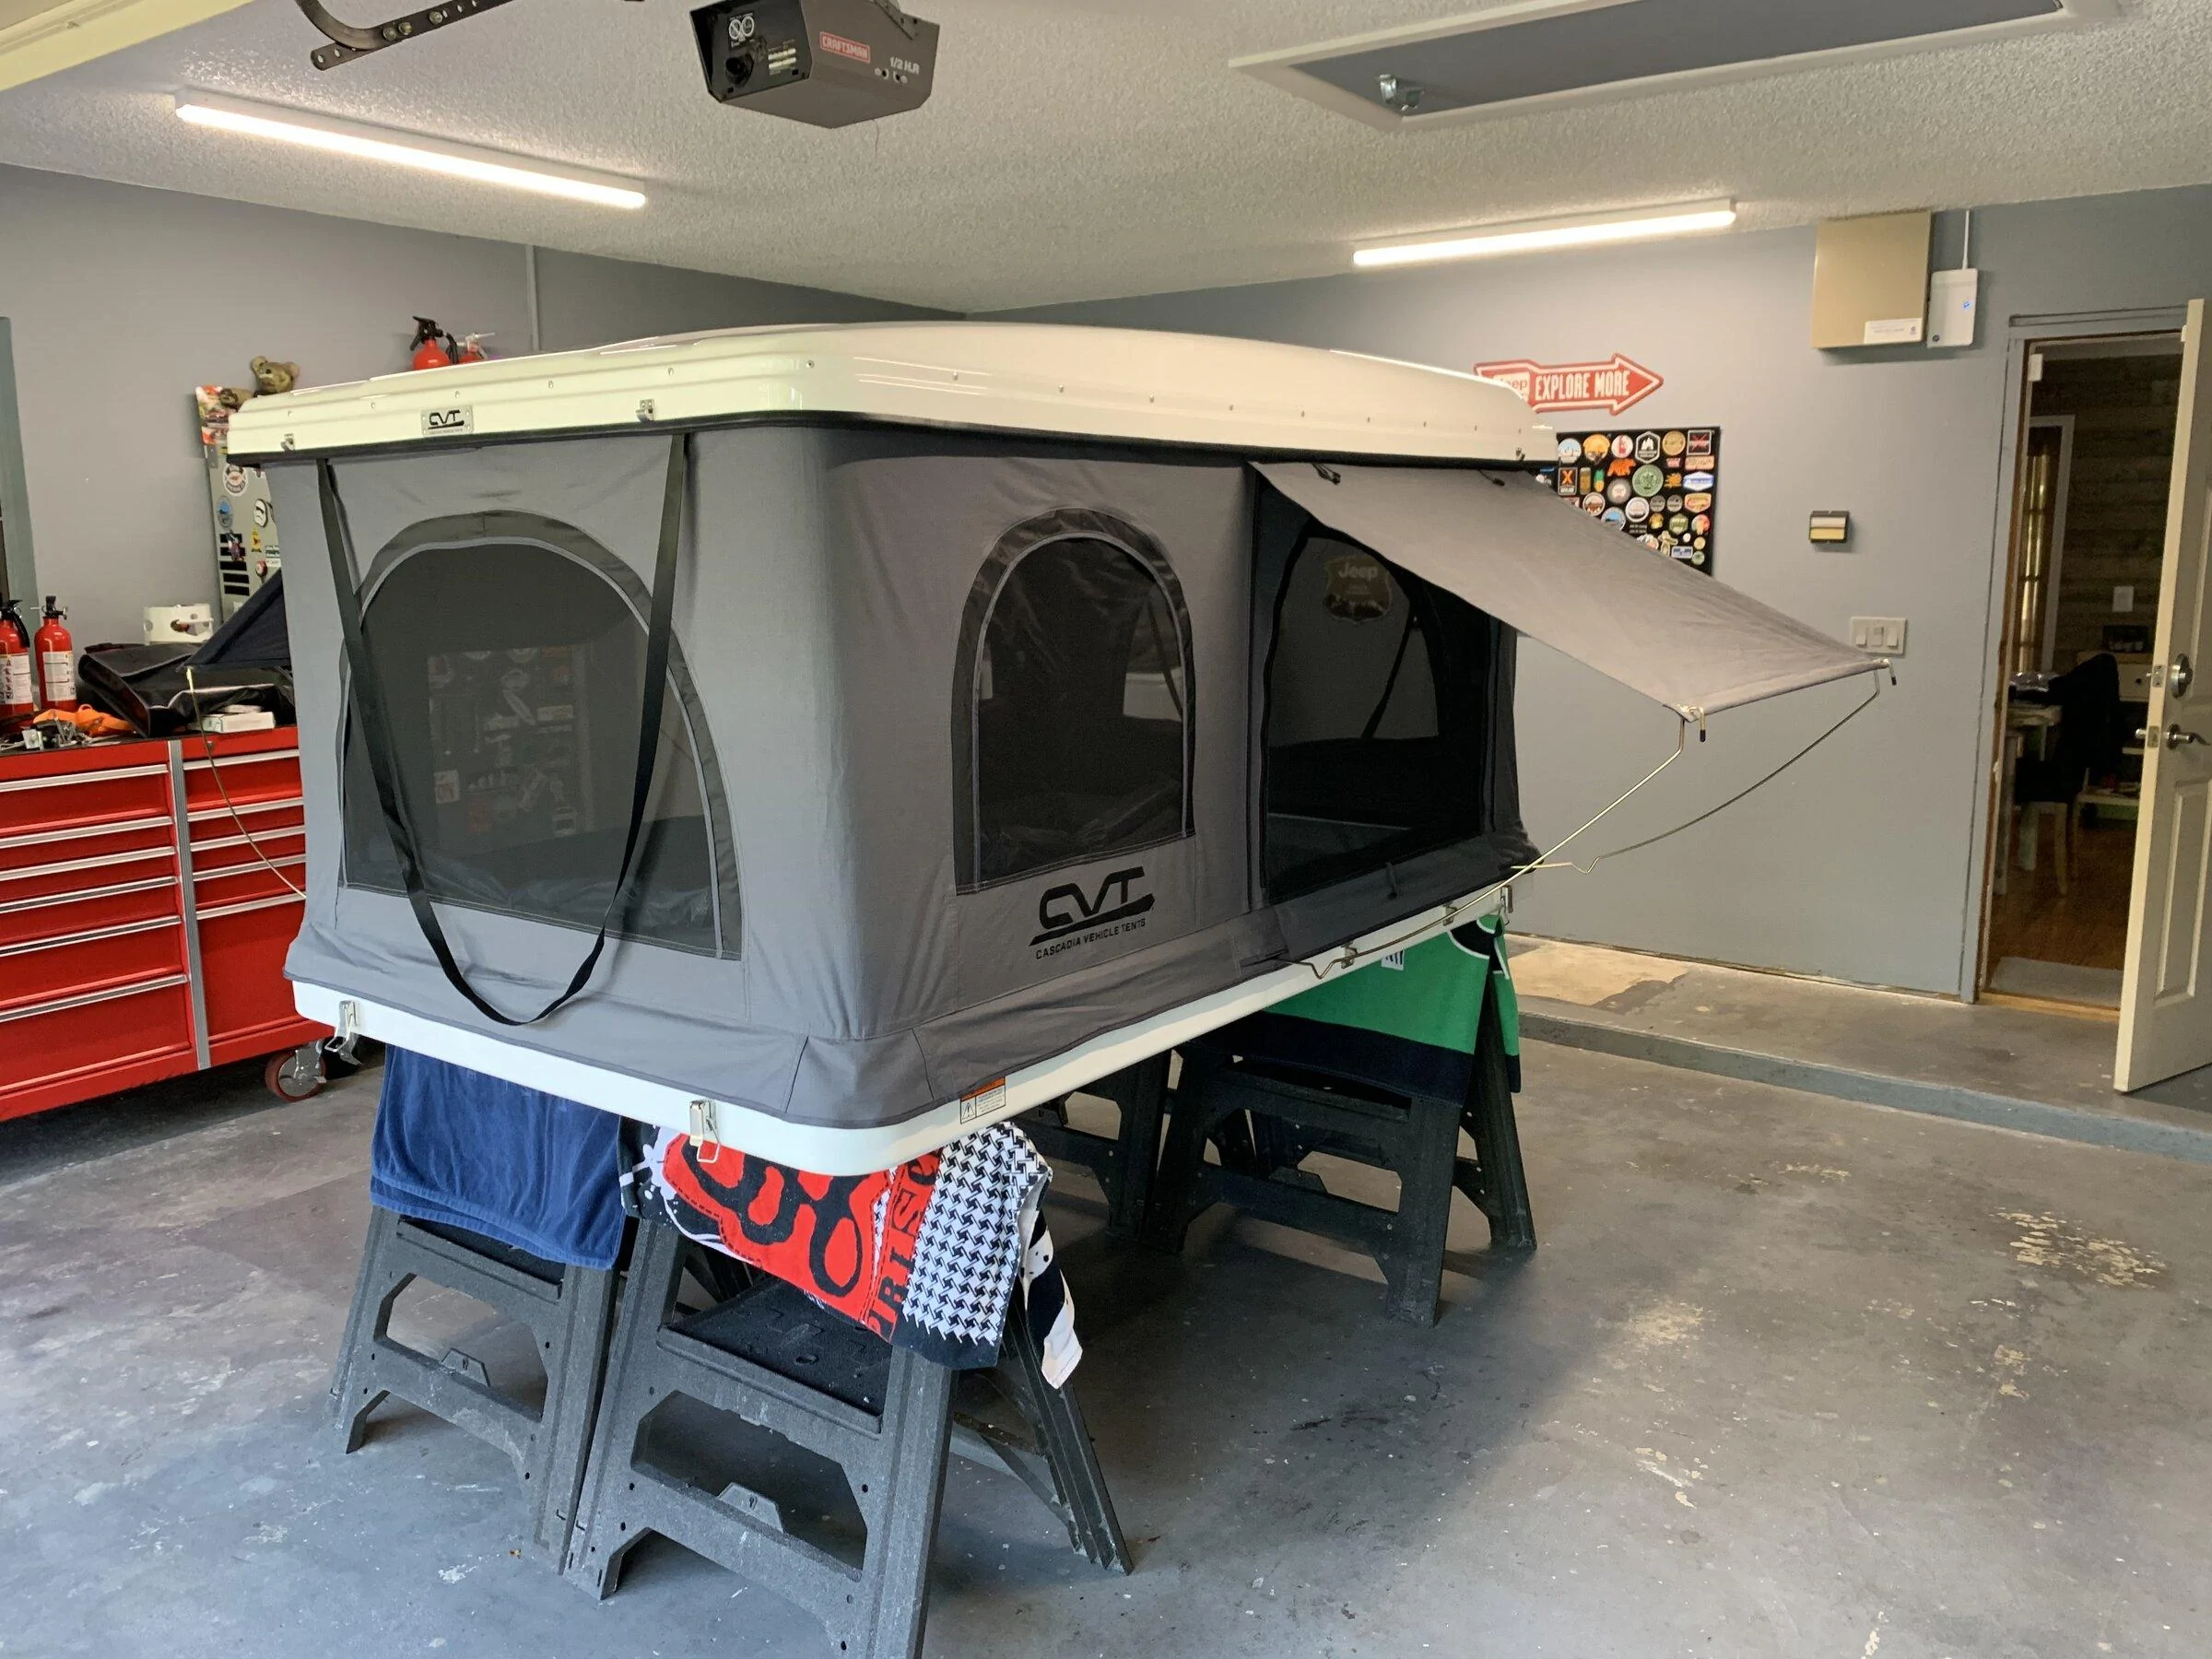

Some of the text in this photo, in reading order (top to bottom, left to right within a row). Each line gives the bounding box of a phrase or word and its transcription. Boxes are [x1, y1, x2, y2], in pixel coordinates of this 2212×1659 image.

[821, 35, 868, 59] CRAFTSMAN
[889, 56, 903, 70] 1/2
[1535, 370, 1630, 401] EXPLORE MORE
[429, 409, 461, 426] CVT
[1039, 865, 1146, 930] CVT
[1035, 918, 1146, 959] CASCADIA VEHICLE TENTS
